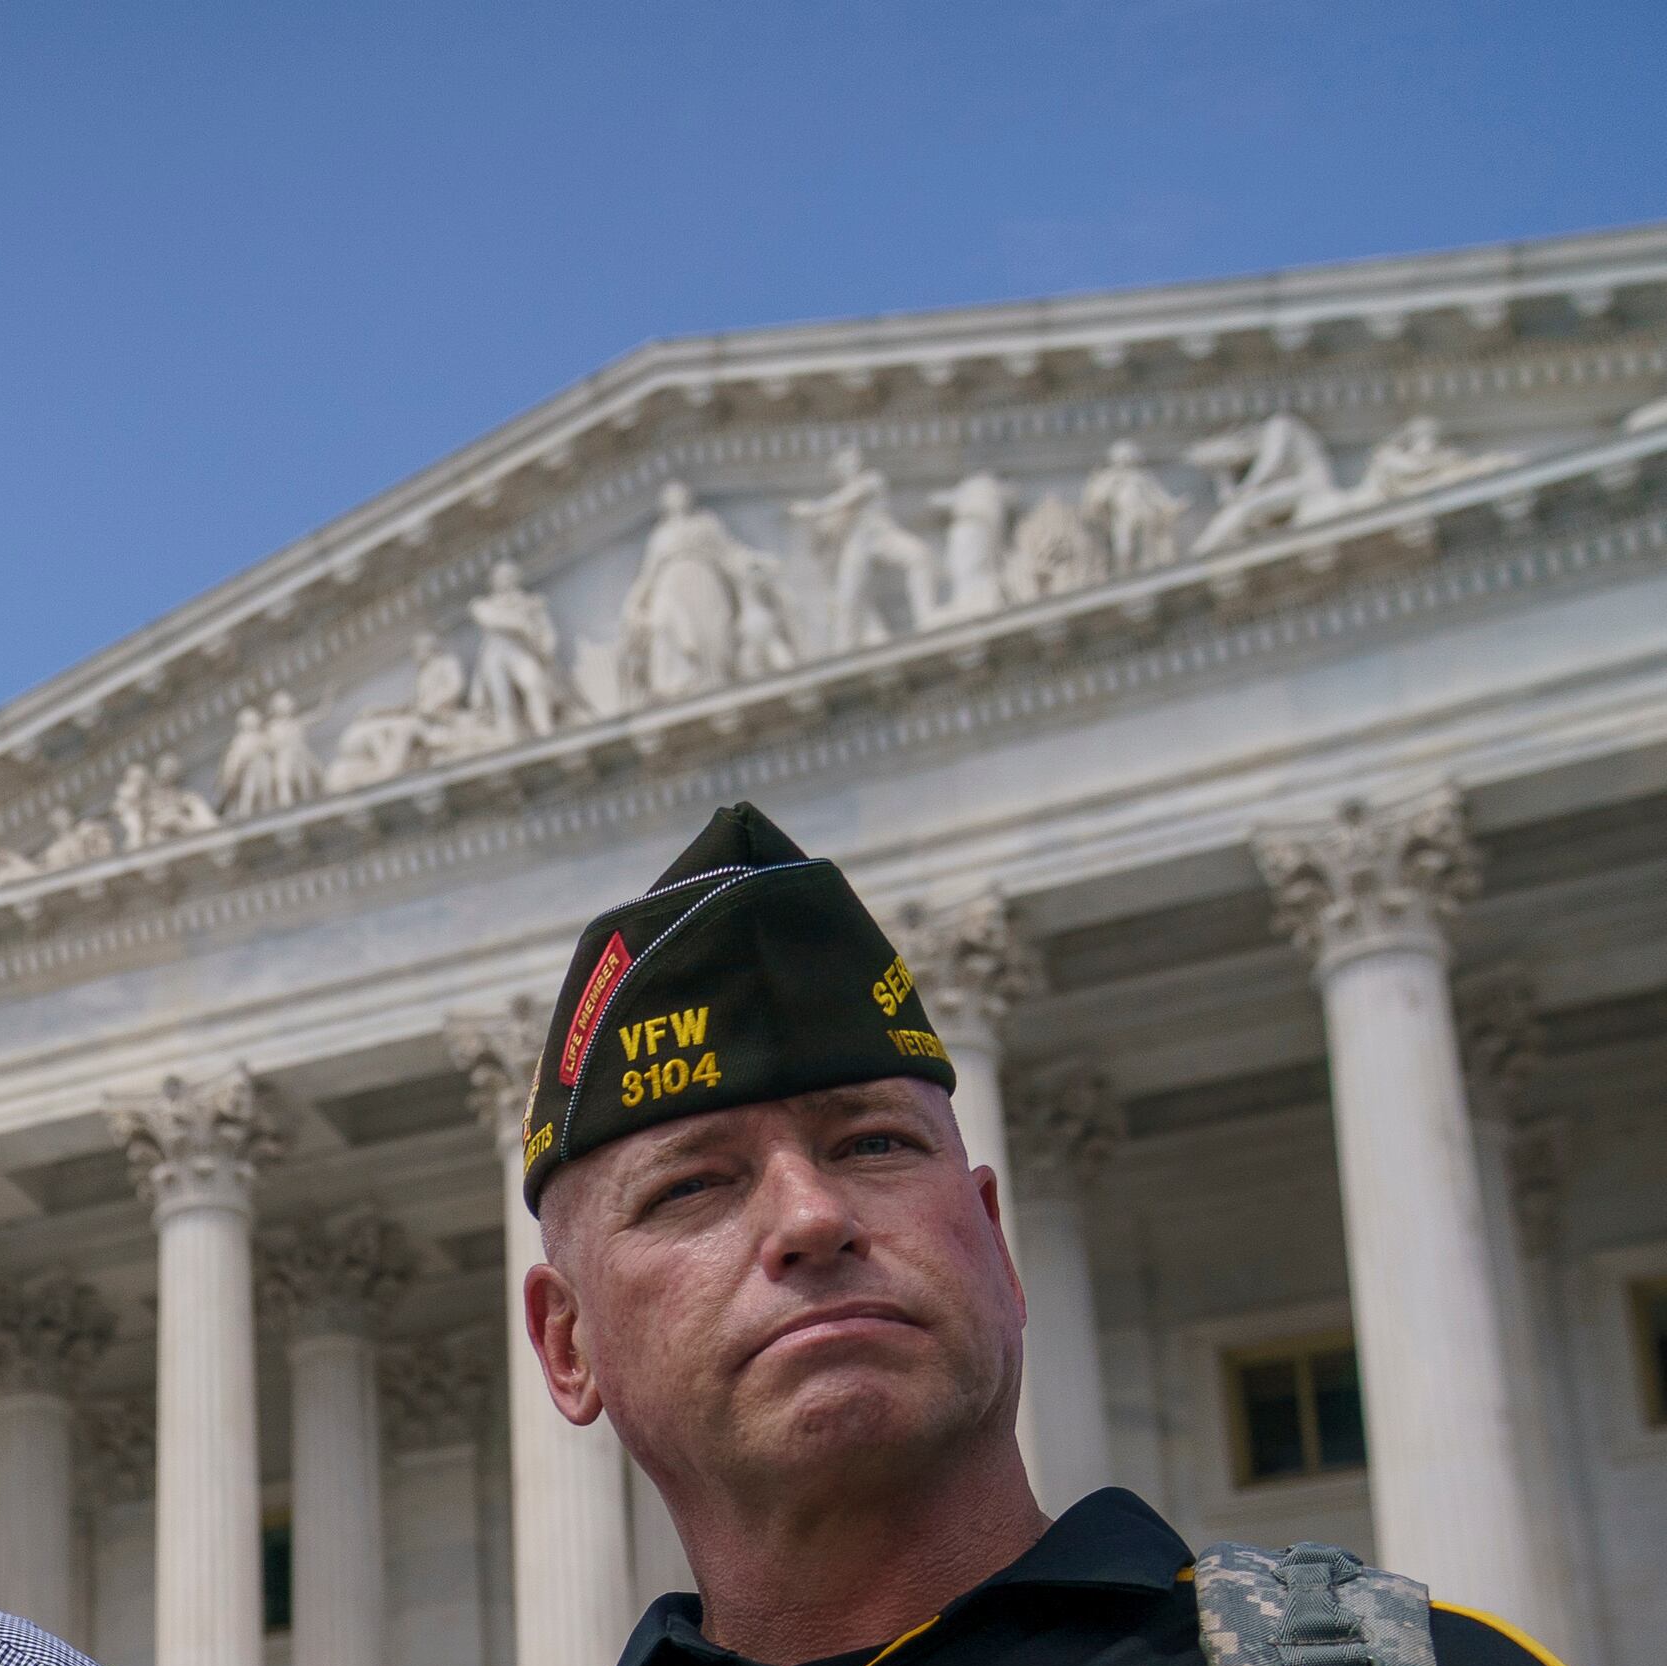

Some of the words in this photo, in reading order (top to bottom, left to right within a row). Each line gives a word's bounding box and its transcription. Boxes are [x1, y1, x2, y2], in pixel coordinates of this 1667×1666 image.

[564, 1032, 583, 1073] LIFE
[578, 952, 620, 1030] MEMBER
[618, 1006, 710, 1061] VFW
[621, 1052, 722, 1108] 3104
[524, 1121, 553, 1176] ETTS
